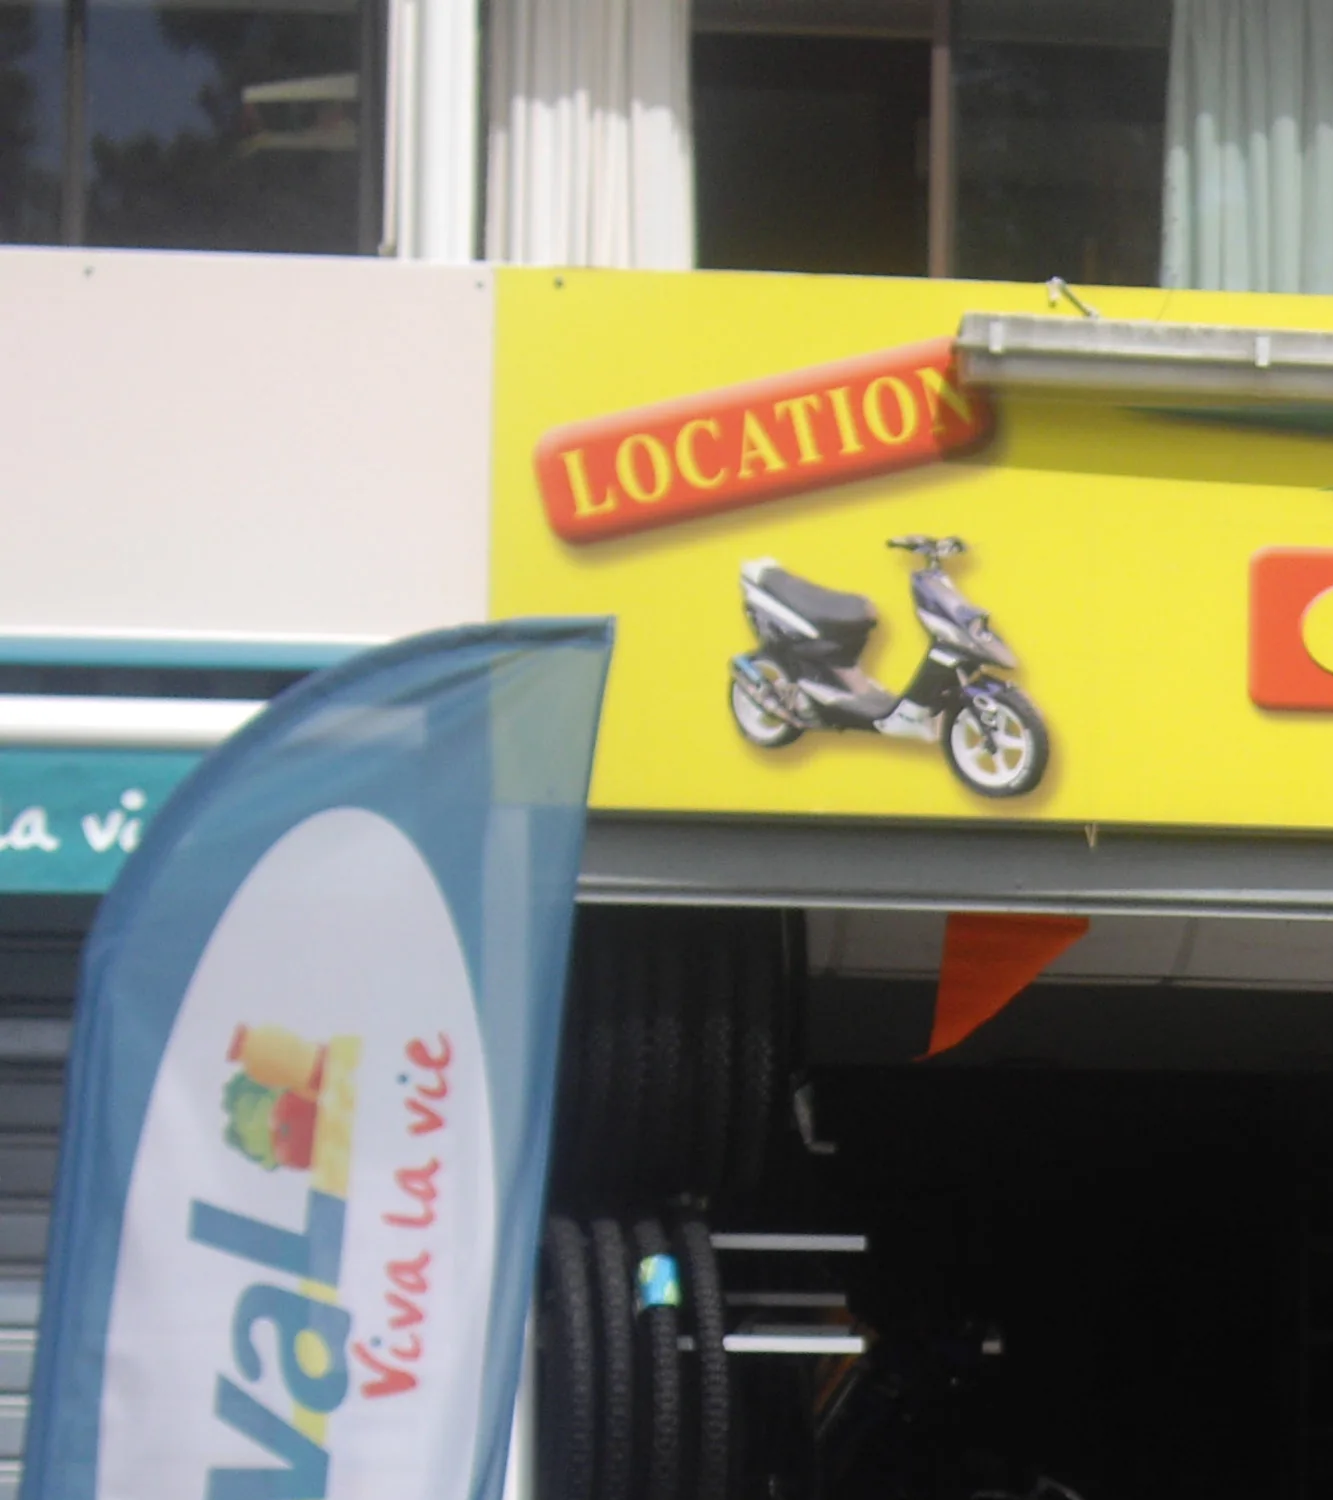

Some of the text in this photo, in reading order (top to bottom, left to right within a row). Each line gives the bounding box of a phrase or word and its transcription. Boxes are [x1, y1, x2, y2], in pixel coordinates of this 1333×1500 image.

[561, 366, 977, 519] LOCATION
[0, 788, 147, 853] a vi
[397, 1031, 452, 1140] vie
